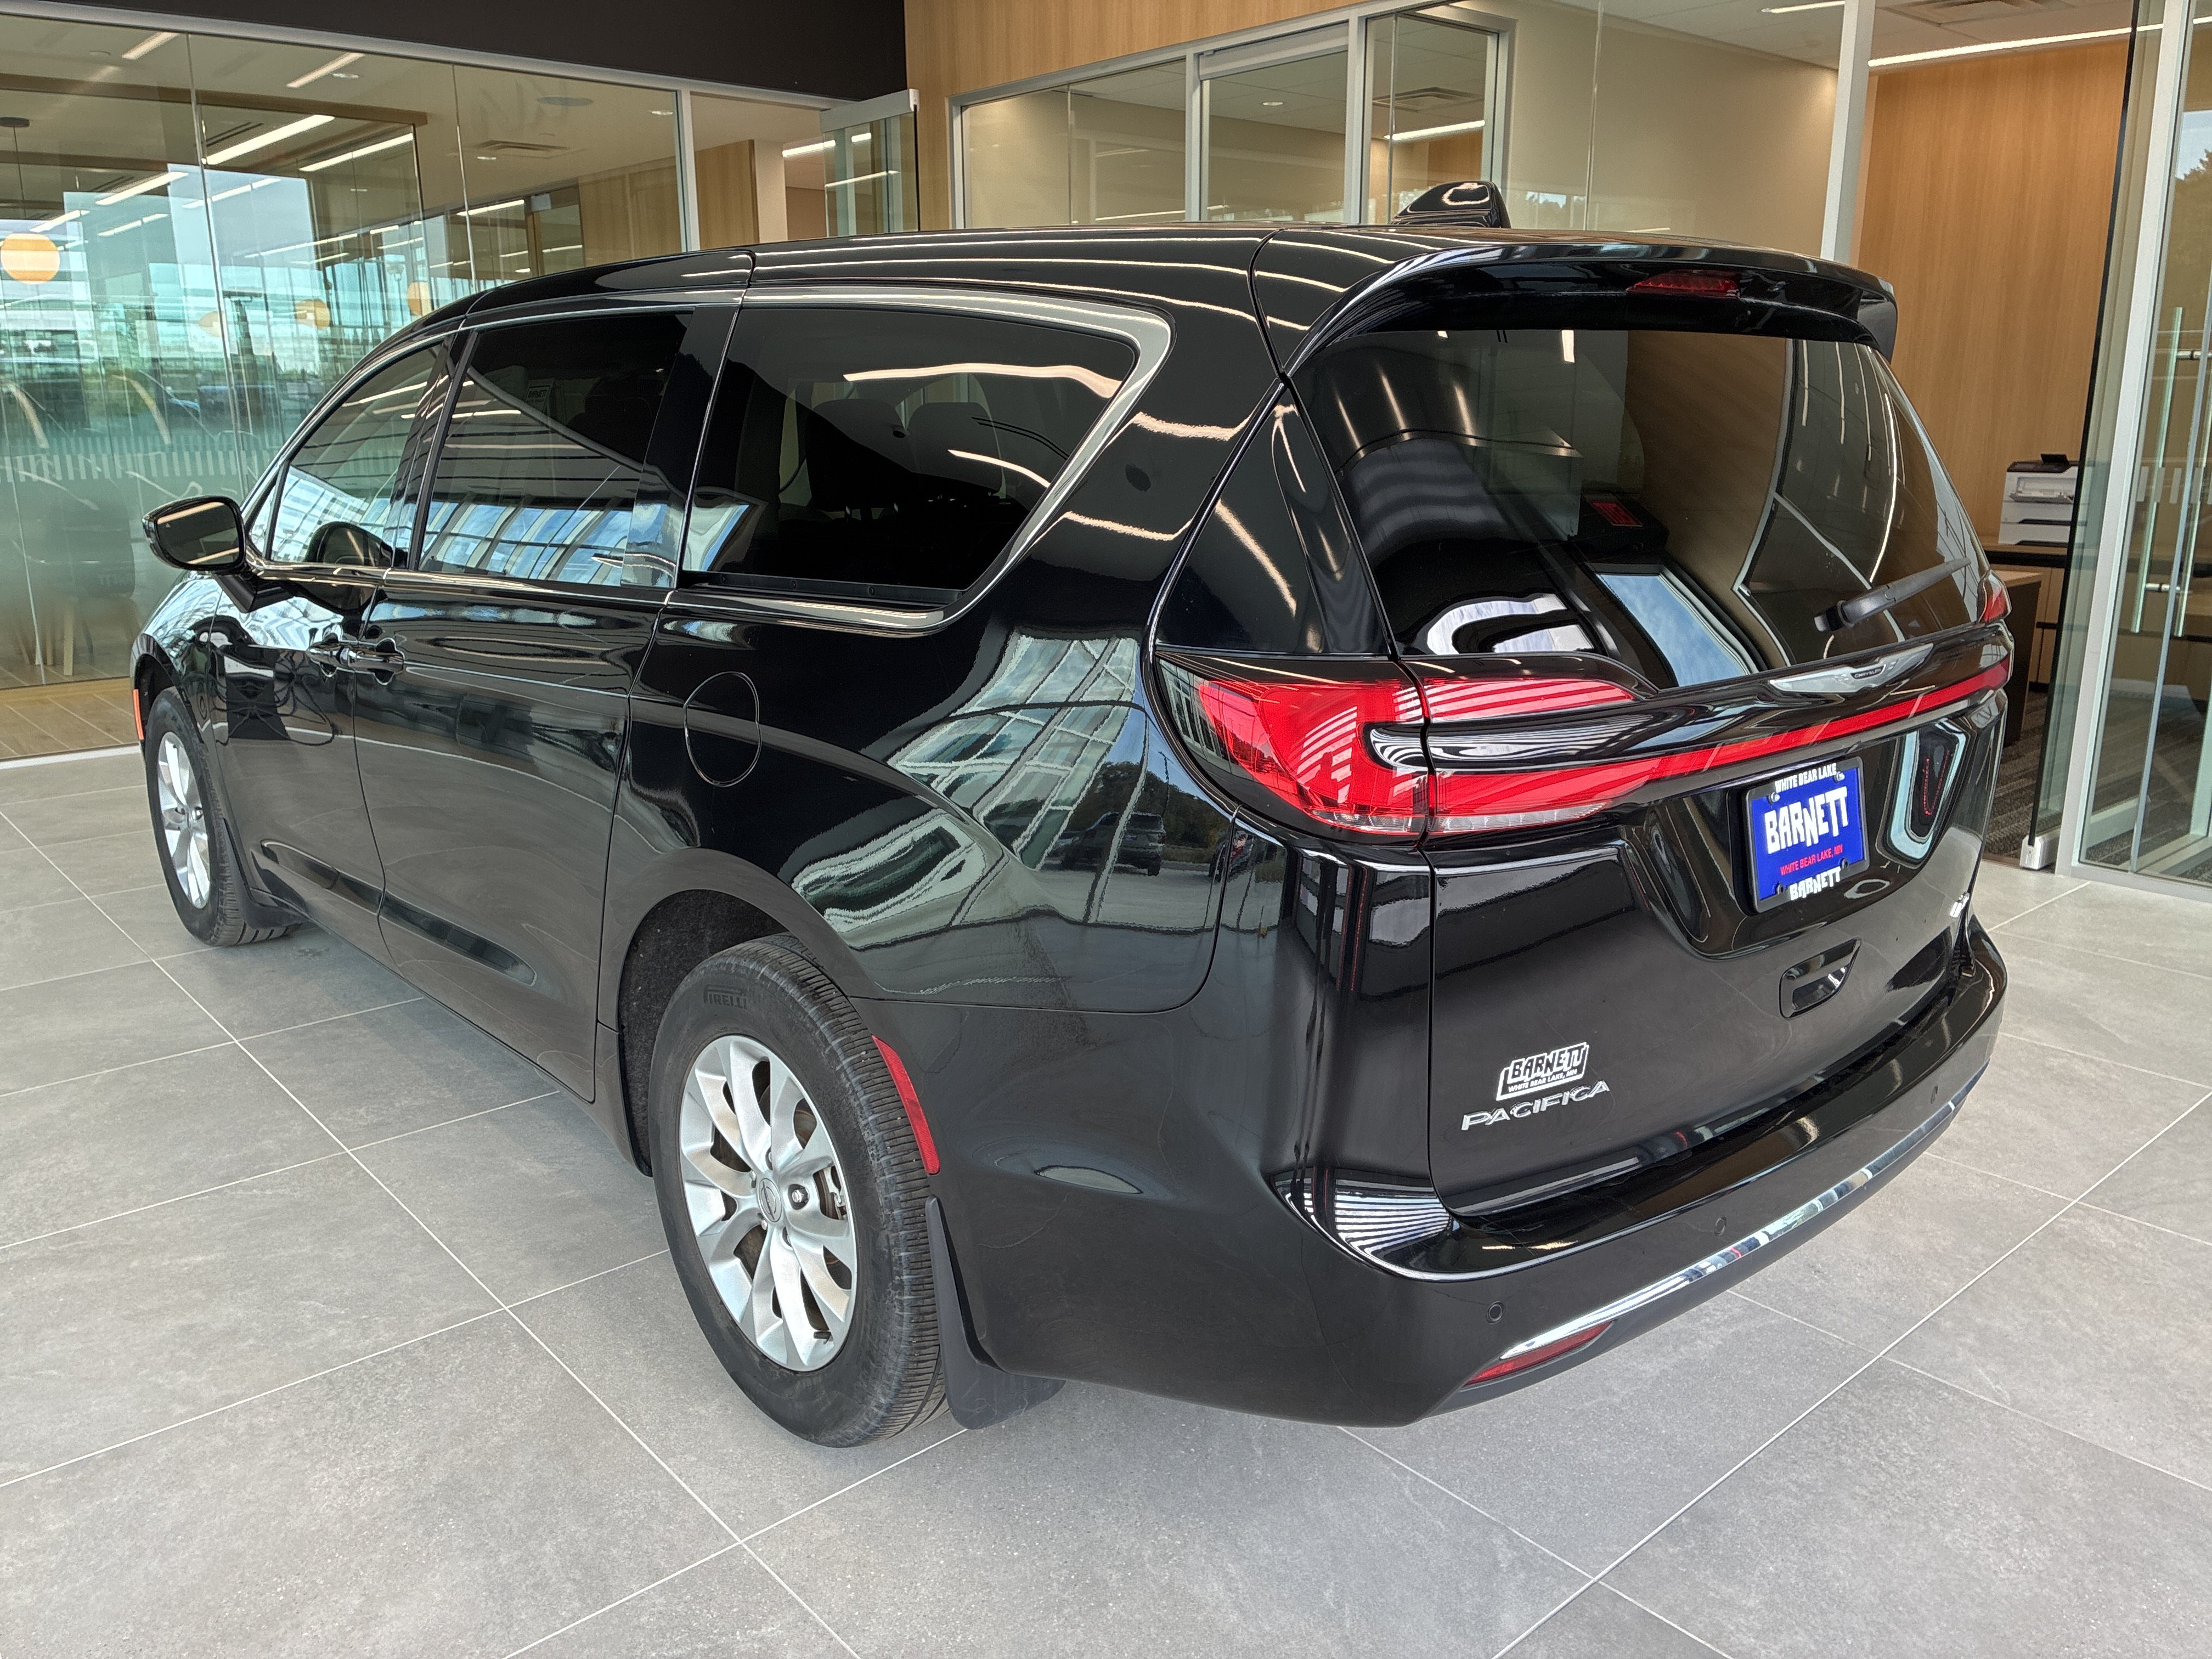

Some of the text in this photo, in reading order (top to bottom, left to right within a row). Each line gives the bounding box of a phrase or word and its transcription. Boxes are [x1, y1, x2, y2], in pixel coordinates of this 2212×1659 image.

[1775, 763, 1837, 793] WHITE BEAR LAKE
[1764, 786, 1848, 854] BARNETT
[1780, 860, 1799, 876] WHITE
[1799, 854, 1816, 868] BEAR
[1789, 866, 1841, 900] BARNETT
[1510, 1043, 1585, 1080] BARNETT
[1509, 1069, 1577, 1092] WHITE BEAR LAKE, MN
[1461, 1080, 1610, 1131] PACIFICA
